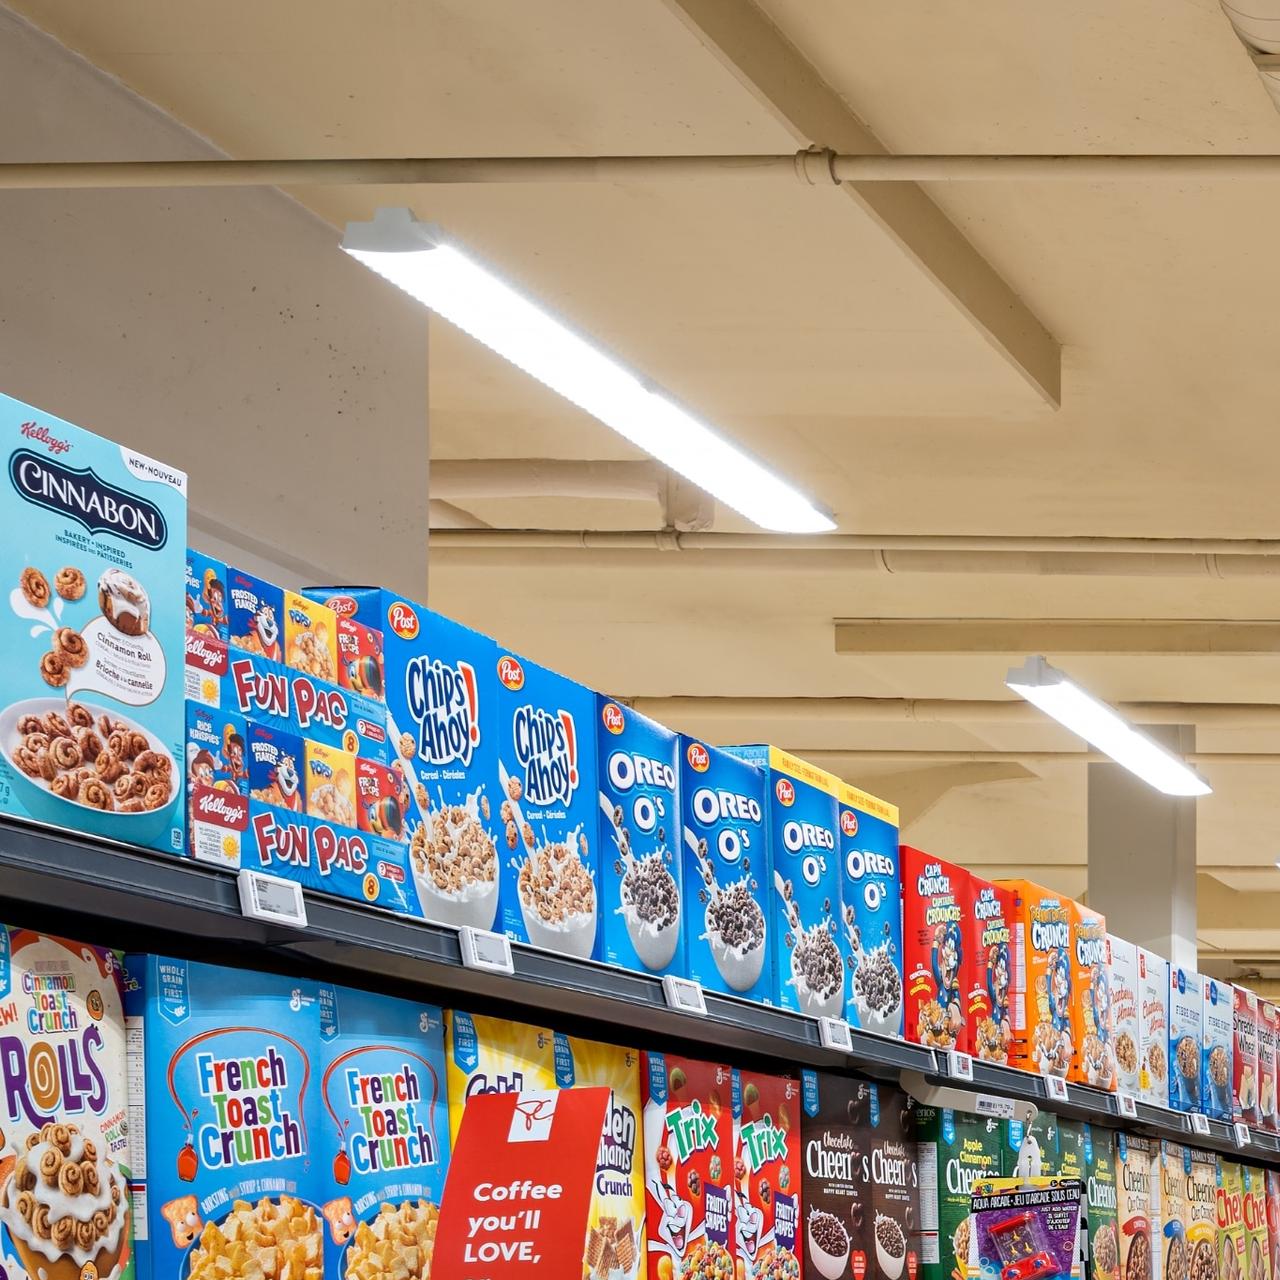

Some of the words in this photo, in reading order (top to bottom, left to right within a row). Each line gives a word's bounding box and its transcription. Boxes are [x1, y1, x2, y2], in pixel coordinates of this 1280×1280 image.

[21, 421, 73, 454] Kellogg's
[19, 460, 159, 540] CINNABON
[64, 529, 91, 546] BAKERY
[95, 541, 125, 558] INSPIRED
[231, 588, 258, 605] FROSTED
[234, 600, 257, 615] FLAKES
[500, 660, 521, 682] Post
[231, 659, 289, 718] FUN
[292, 677, 348, 730] PAC
[406, 655, 466, 719] Chips
[196, 720, 212, 733] RICE
[513, 705, 565, 768] Chips
[251, 741, 279, 758] FROSTED
[255, 752, 278, 766] FLAKES
[691, 748, 708, 765] Post
[608, 752, 676, 791] OREO
[199, 794, 246, 823] Kellogg's
[693, 788, 762, 824] OREO
[252, 811, 310, 867] FUN
[313, 825, 369, 876] PAC
[783, 821, 834, 851] OREO
[847, 850, 894, 880] OREO
[918, 875, 950, 897] CRUNCH
[975, 901, 1001, 921] CRUNCH
[1031, 922, 1070, 951] CRUNCH
[159, 966, 185, 977] WHOLE
[162, 975, 183, 985] GRAIN
[164, 988, 183, 998] FIRST
[0, 1023, 108, 1132] ROLLS
[197, 1047, 288, 1095] French
[346, 1064, 420, 1107] French
[359, 1102, 417, 1138] Toast
[666, 1099, 720, 1164] Trix
[200, 1113, 302, 1169] Crunch
[351, 1125, 433, 1174] Crunch
[741, 1112, 788, 1174] Trix
[883, 1140, 906, 1156] Chocolate
[963, 1138, 983, 1152] Apple
[959, 1151, 992, 1165] Cinnamon
[473, 1180, 563, 1202] Coffee
[705, 1192, 728, 1217] FRUITY
[972, 1197, 988, 1210] AQUA
[990, 1193, 1011, 1208] ARCADE
[1051, 1189, 1066, 1201] SOUS
[468, 1209, 541, 1239] you'll
[705, 1210, 727, 1234] SHAPES
[464, 1241, 542, 1265] LOVE,
